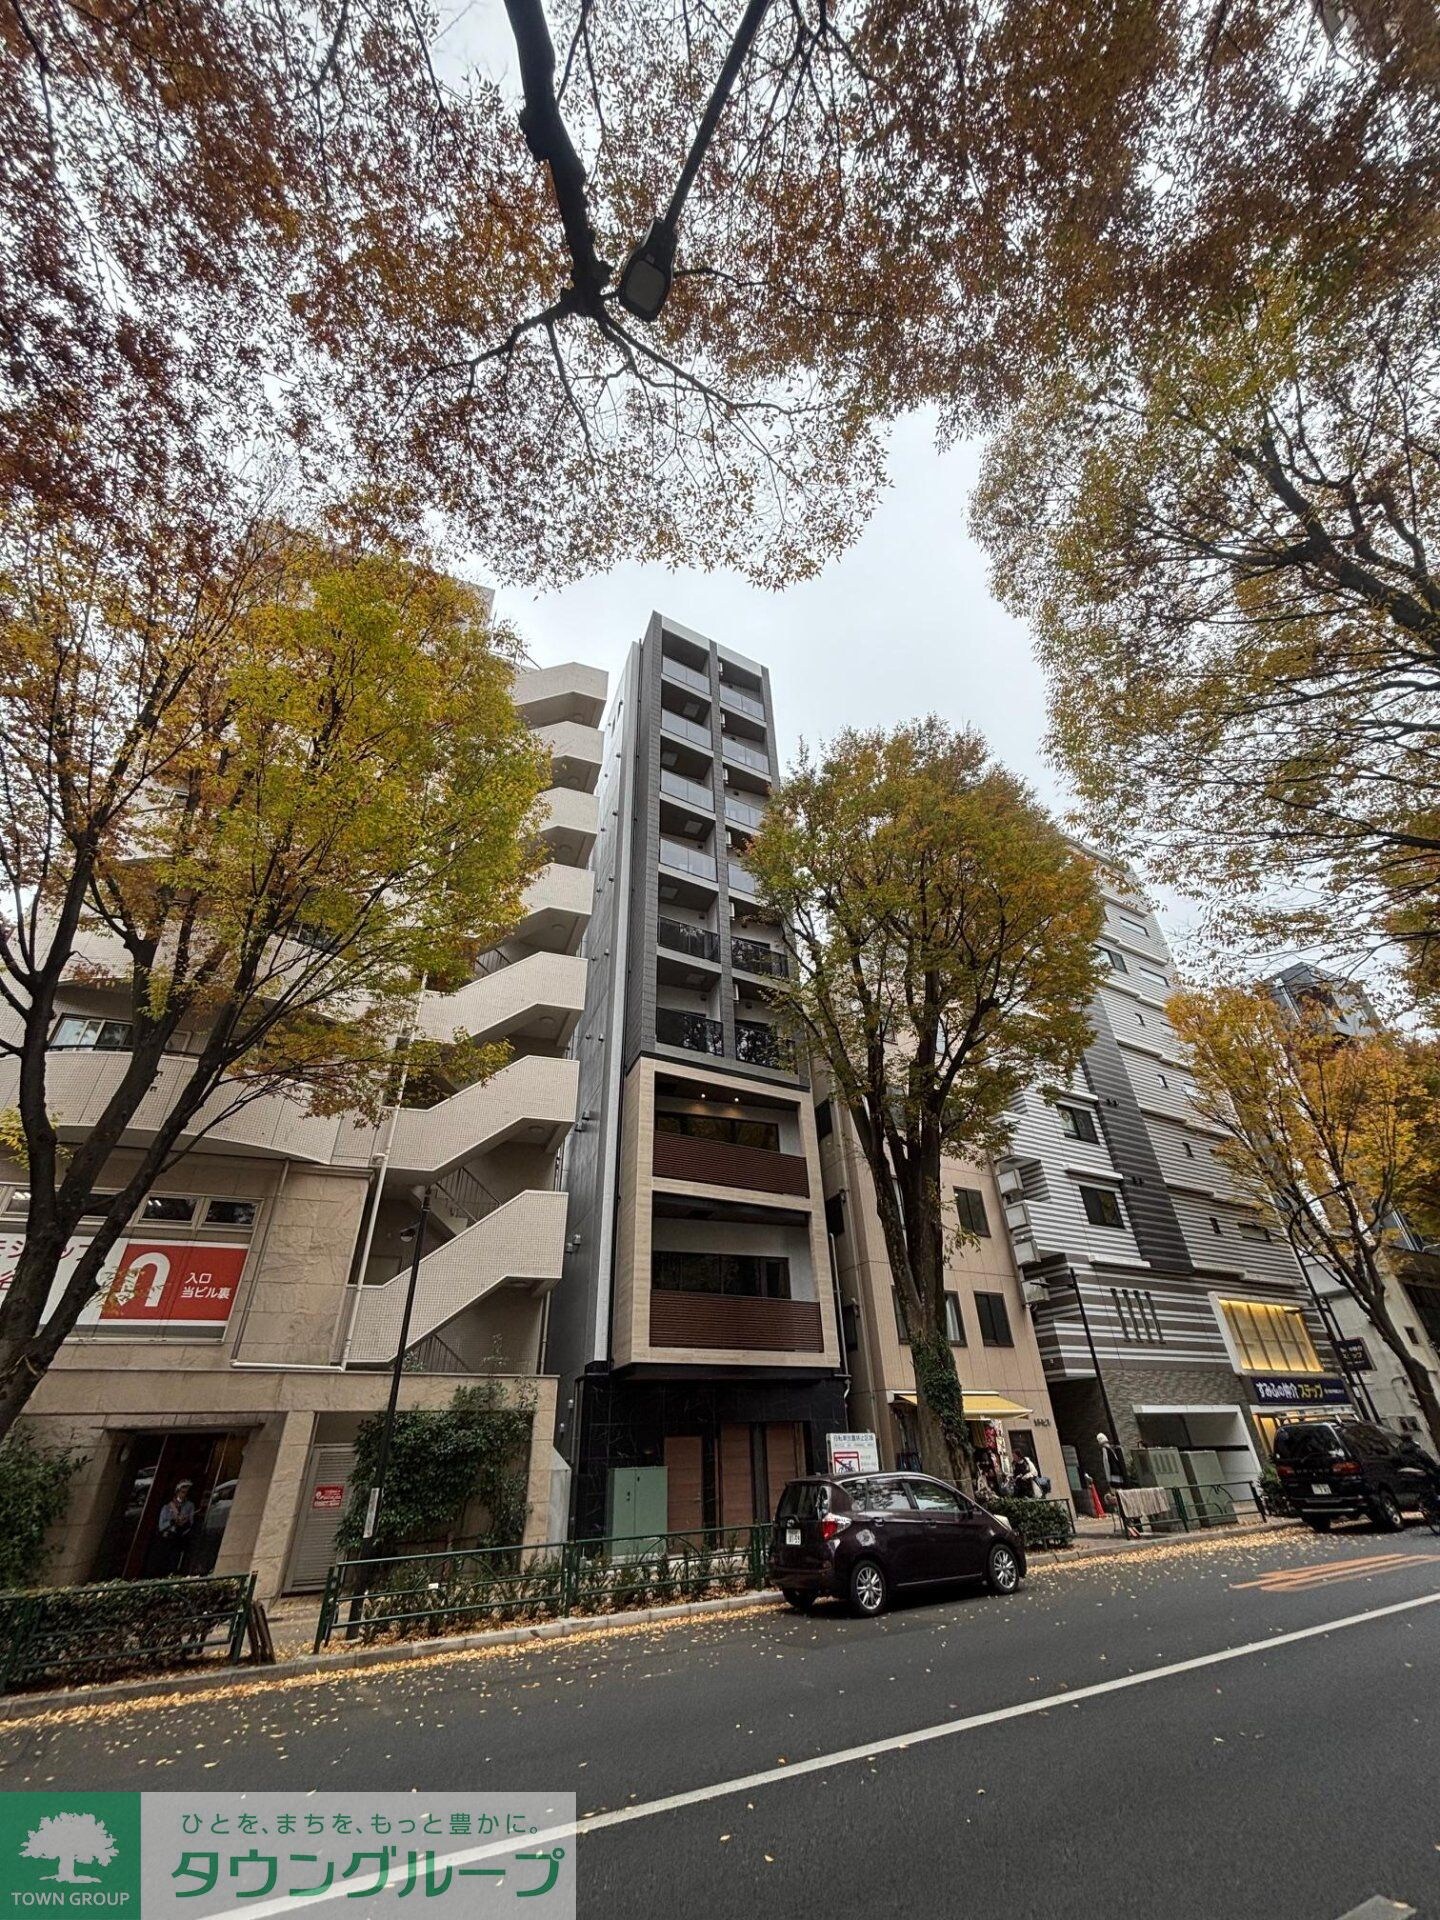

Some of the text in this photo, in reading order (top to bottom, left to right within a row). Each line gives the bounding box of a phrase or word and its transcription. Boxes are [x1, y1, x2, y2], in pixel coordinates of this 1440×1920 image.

[185, 1272, 212, 1284] 入口
[181, 1286, 232, 1300] 当ビル裏
[1298, 1383, 1323, 1399] ステップ
